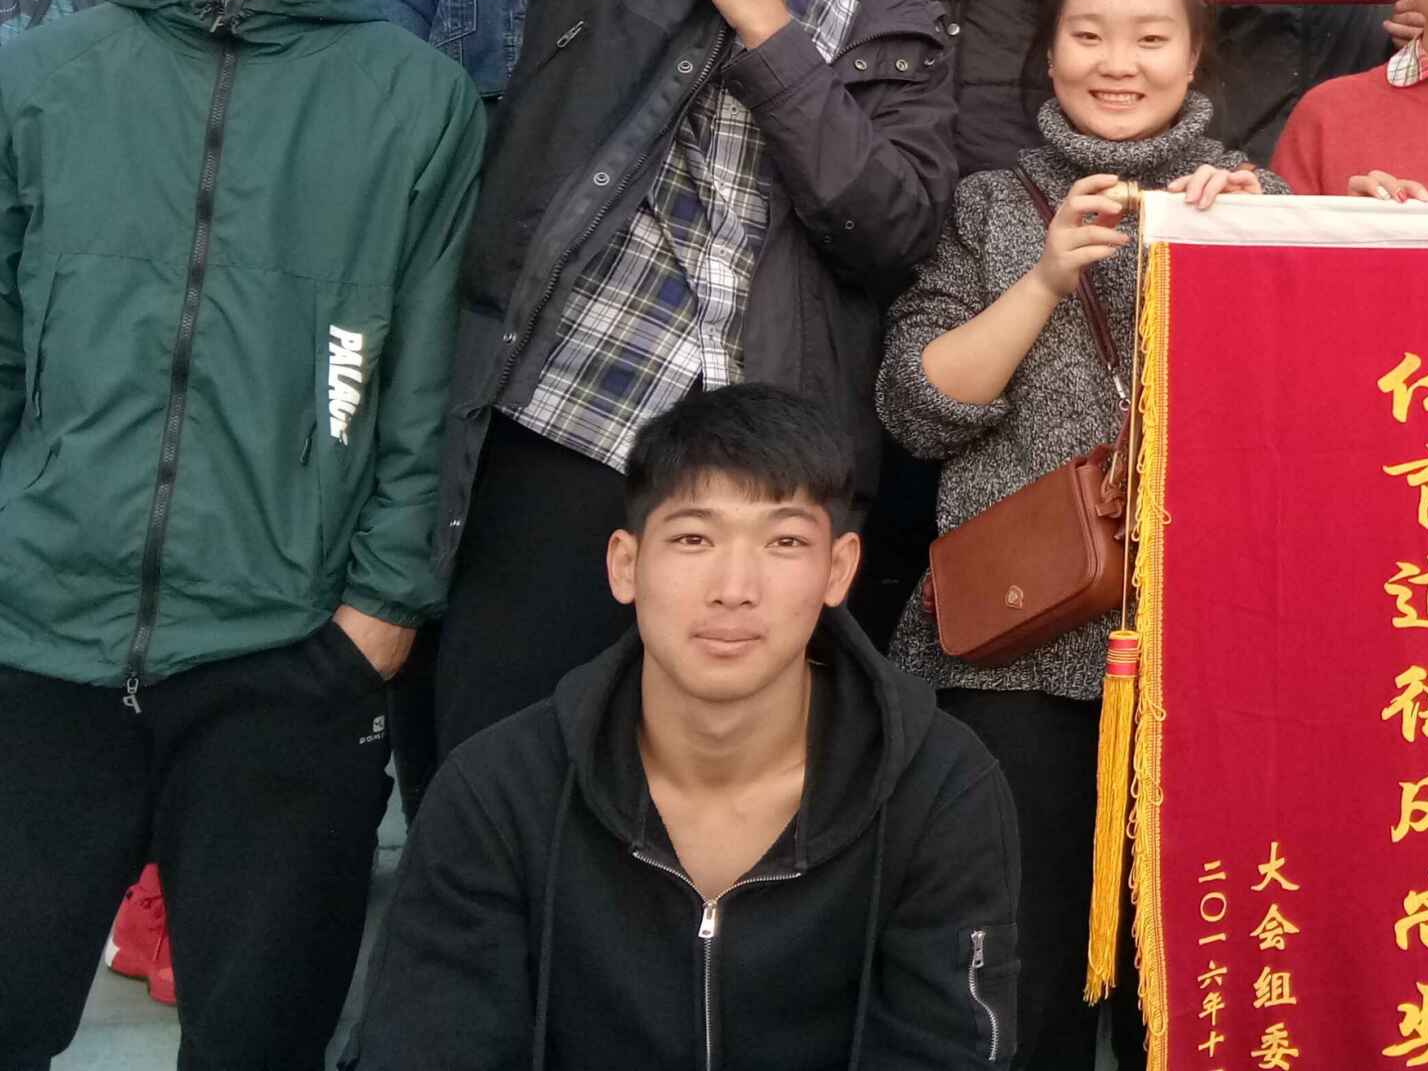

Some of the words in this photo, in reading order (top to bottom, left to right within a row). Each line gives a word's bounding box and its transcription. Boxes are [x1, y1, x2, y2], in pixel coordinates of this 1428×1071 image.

[1197, 860, 1229, 1071] 二〇一六年十
